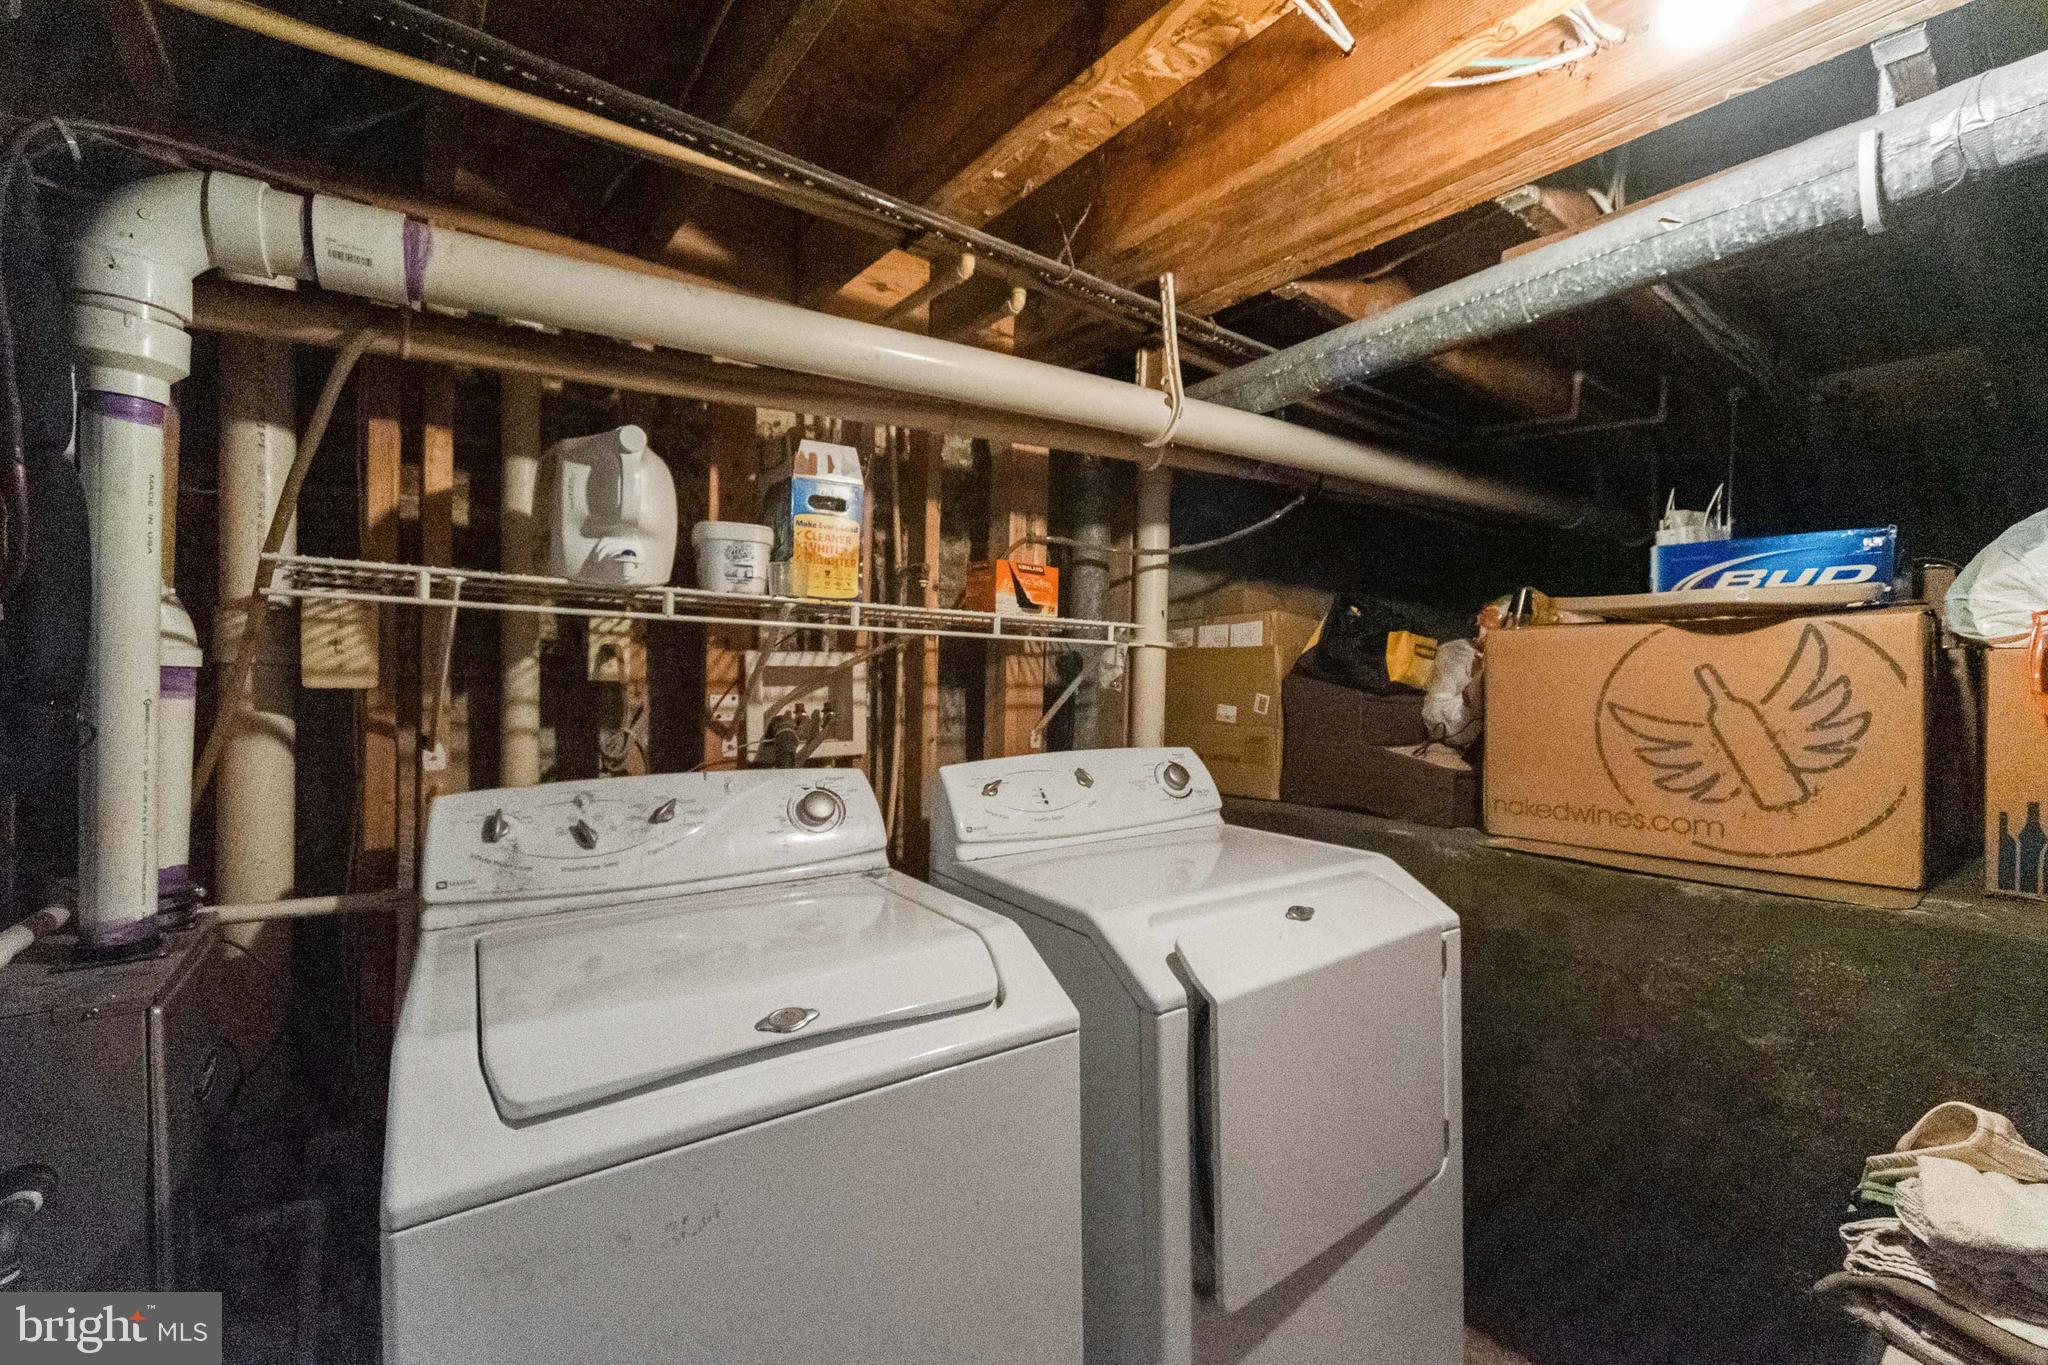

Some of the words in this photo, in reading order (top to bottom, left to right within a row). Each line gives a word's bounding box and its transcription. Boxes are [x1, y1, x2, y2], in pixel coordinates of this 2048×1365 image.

[147, 513, 154, 526] IN
[1713, 563, 1878, 590] BUD
[1492, 796, 1725, 839] nakedwines.com
